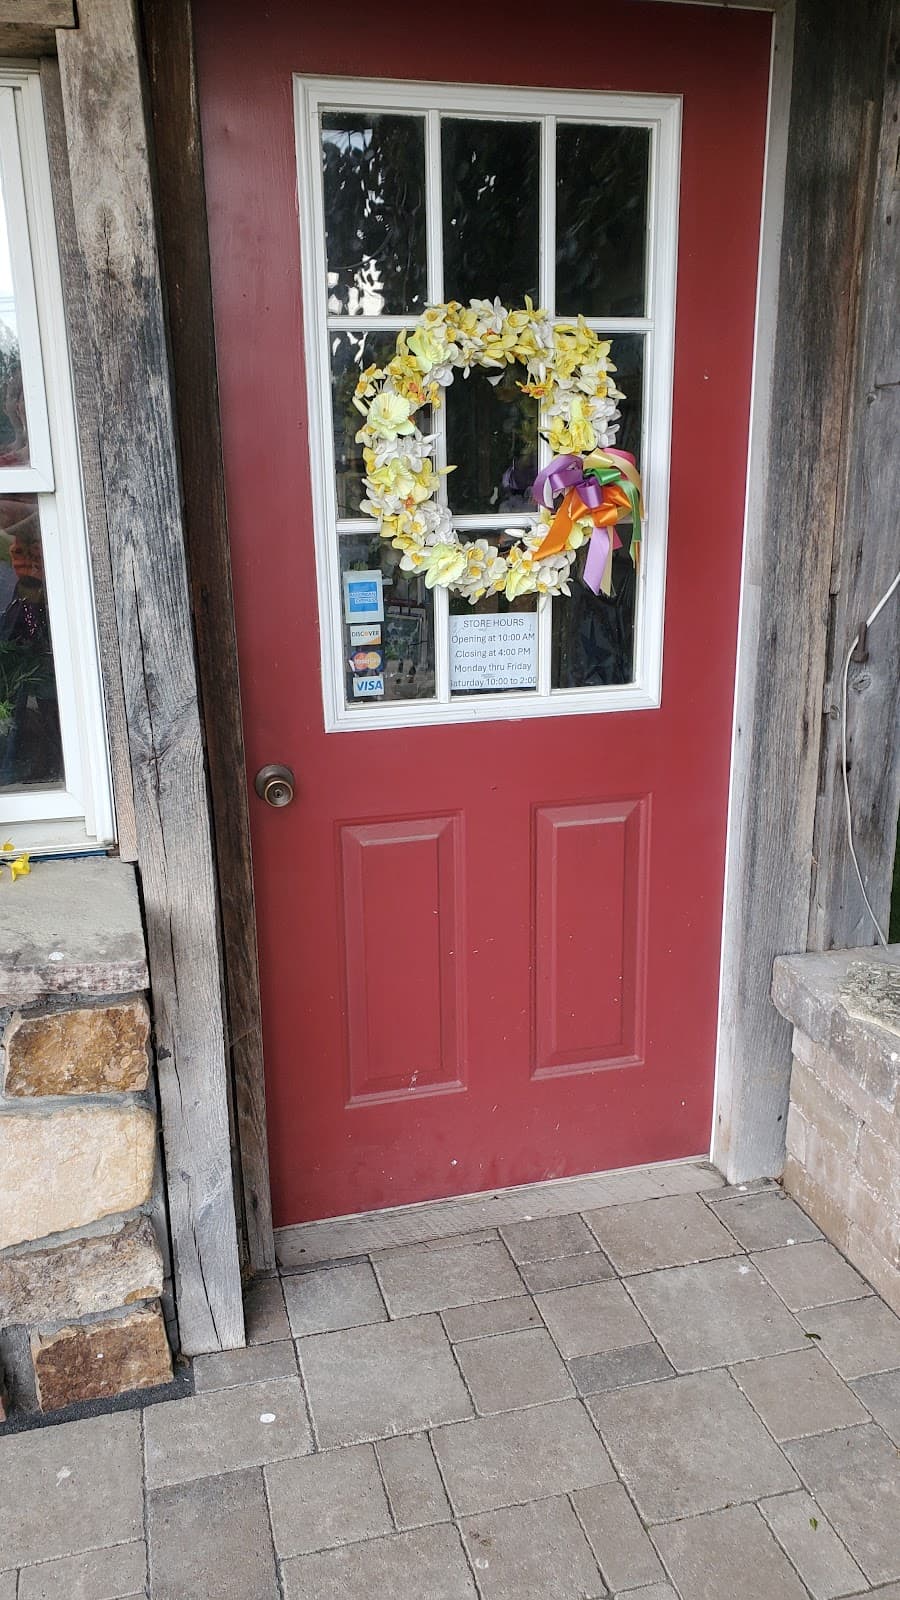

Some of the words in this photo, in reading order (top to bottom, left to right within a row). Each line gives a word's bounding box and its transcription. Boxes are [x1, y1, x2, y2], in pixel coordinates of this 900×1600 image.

[463, 619, 492, 628] STORE
[493, 618, 524, 627] HOURS
[451, 634, 487, 644] Opening
[499, 633, 521, 642] 10:00
[522, 632, 535, 641] AM
[455, 649, 487, 659] Closing
[488, 649, 497, 657] at
[498, 648, 516, 656] 4:00
[517, 647, 531, 656] PM
[454, 663, 487, 673] Monday
[489, 662, 505, 672] thru
[507, 661, 532, 671] Friday
[357, 680, 383, 691] VISA
[450, 677, 484, 688] aturday
[487, 677, 509, 686] 10:00
[510, 676, 518, 685] to
